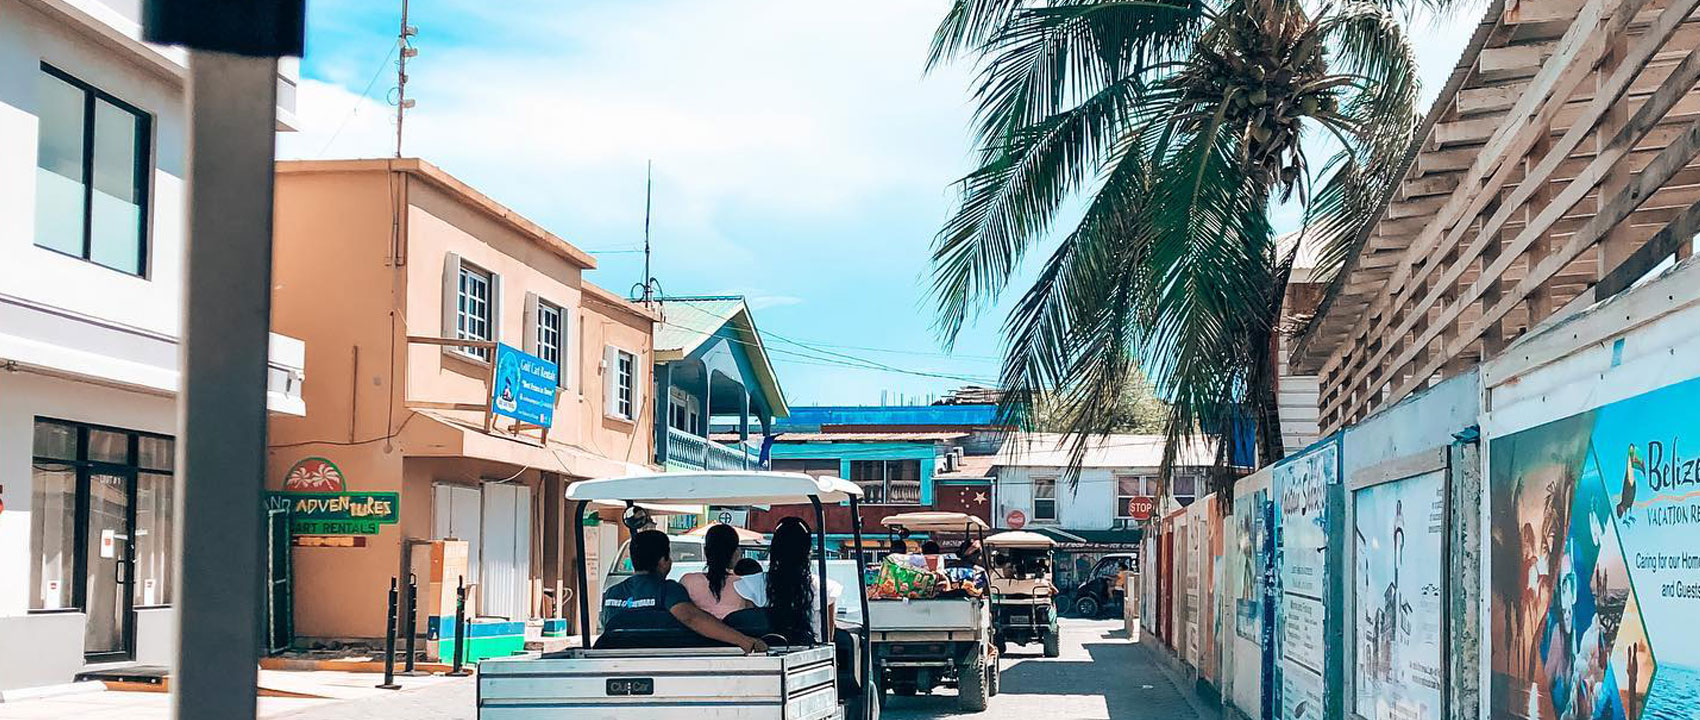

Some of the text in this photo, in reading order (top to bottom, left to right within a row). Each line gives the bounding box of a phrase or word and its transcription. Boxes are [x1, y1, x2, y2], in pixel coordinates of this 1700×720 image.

[1647, 436, 1700, 491] Belize
[296, 496, 392, 516] ADVENTURES
[1131, 502, 1152, 513] STOP
[1647, 505, 1688, 526] VACATION
[323, 522, 376, 534] RENTALS
[1636, 552, 1656, 573] Caring
[1658, 551, 1667, 569] for
[1668, 556, 1680, 569] our
[1662, 580, 1674, 597] and
